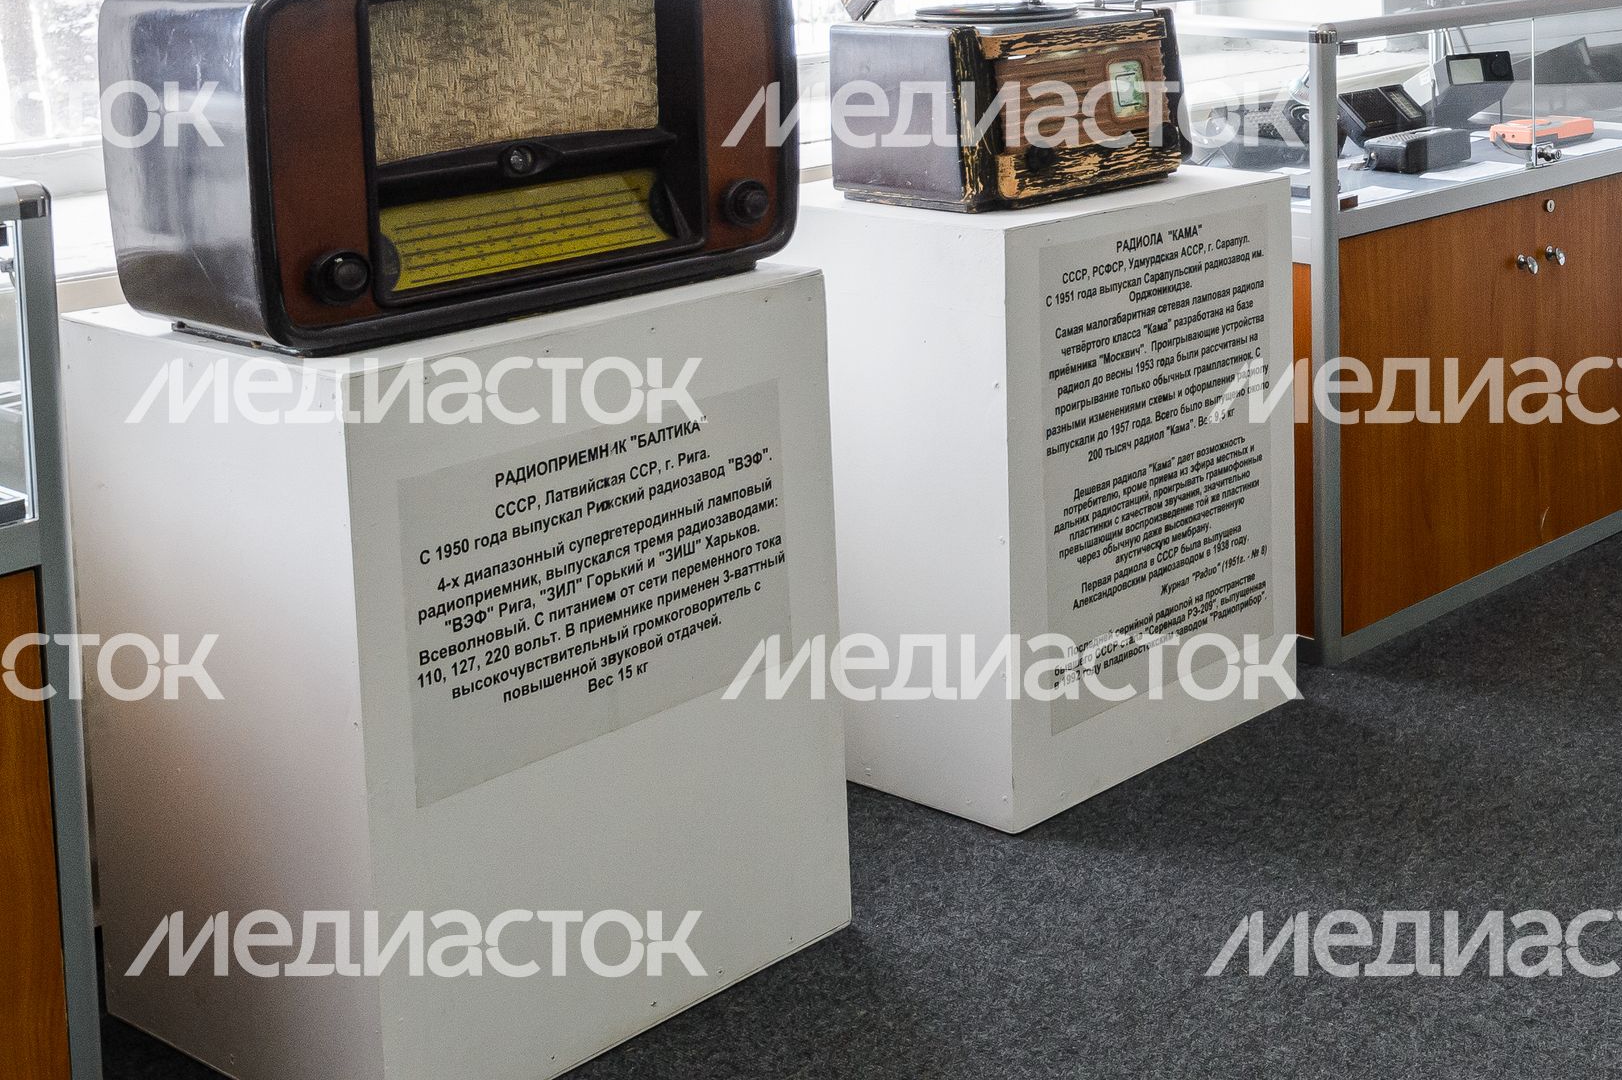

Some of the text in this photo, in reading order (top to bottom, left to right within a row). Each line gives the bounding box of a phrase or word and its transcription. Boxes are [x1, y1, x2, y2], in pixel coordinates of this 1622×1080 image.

[1045, 249, 1264, 307] С 1951 года выпускал Сарапульский радиозавод им.
[1062, 268, 1090, 284] СССР,
[1092, 260, 1126, 277] РСФСР,
[1180, 242, 1206, 257] АССР,
[1215, 235, 1250, 250] Сарапул.
[1116, 224, 1202, 253] РАДИОЛА "КАМА"
[1054, 279, 1264, 339] Самая малогабаритная сетевая ламповая радиола
[1060, 299, 1254, 356] четвёртого класса "Кама" разработана на базе
[1128, 280, 1192, 303] Орджоникидзе.
[419, 447, 772, 565] С 1950 года выпускал Рижский радиозавод "ВЭФ".
[494, 494, 540, 519] СССР,
[544, 473, 626, 505] Латвийская
[629, 460, 661, 480] ССР,
[677, 449, 710, 466] Рига.
[417, 498, 778, 624] радиоприемник, выпускался тремя радиозаводами:
[437, 477, 772, 592] 4-х диапазонный супергетеродинный ламповый
[418, 535, 782, 665] Всеволновый. С питанием от сети переменного тока
[444, 524, 760, 632] "ВЭФ" Рига, "ЗИЛ" Горький и "ЗИШ" Харьков.
[417, 550, 785, 688] 110, 127, 220 вольт. В приемнике применен 3-ваттный
[451, 581, 761, 698] высокочувствительный громкоговоритель с
[503, 613, 721, 702] повышенной звуковой отдачей.
[588, 661, 649, 693] Вес 15 кг
